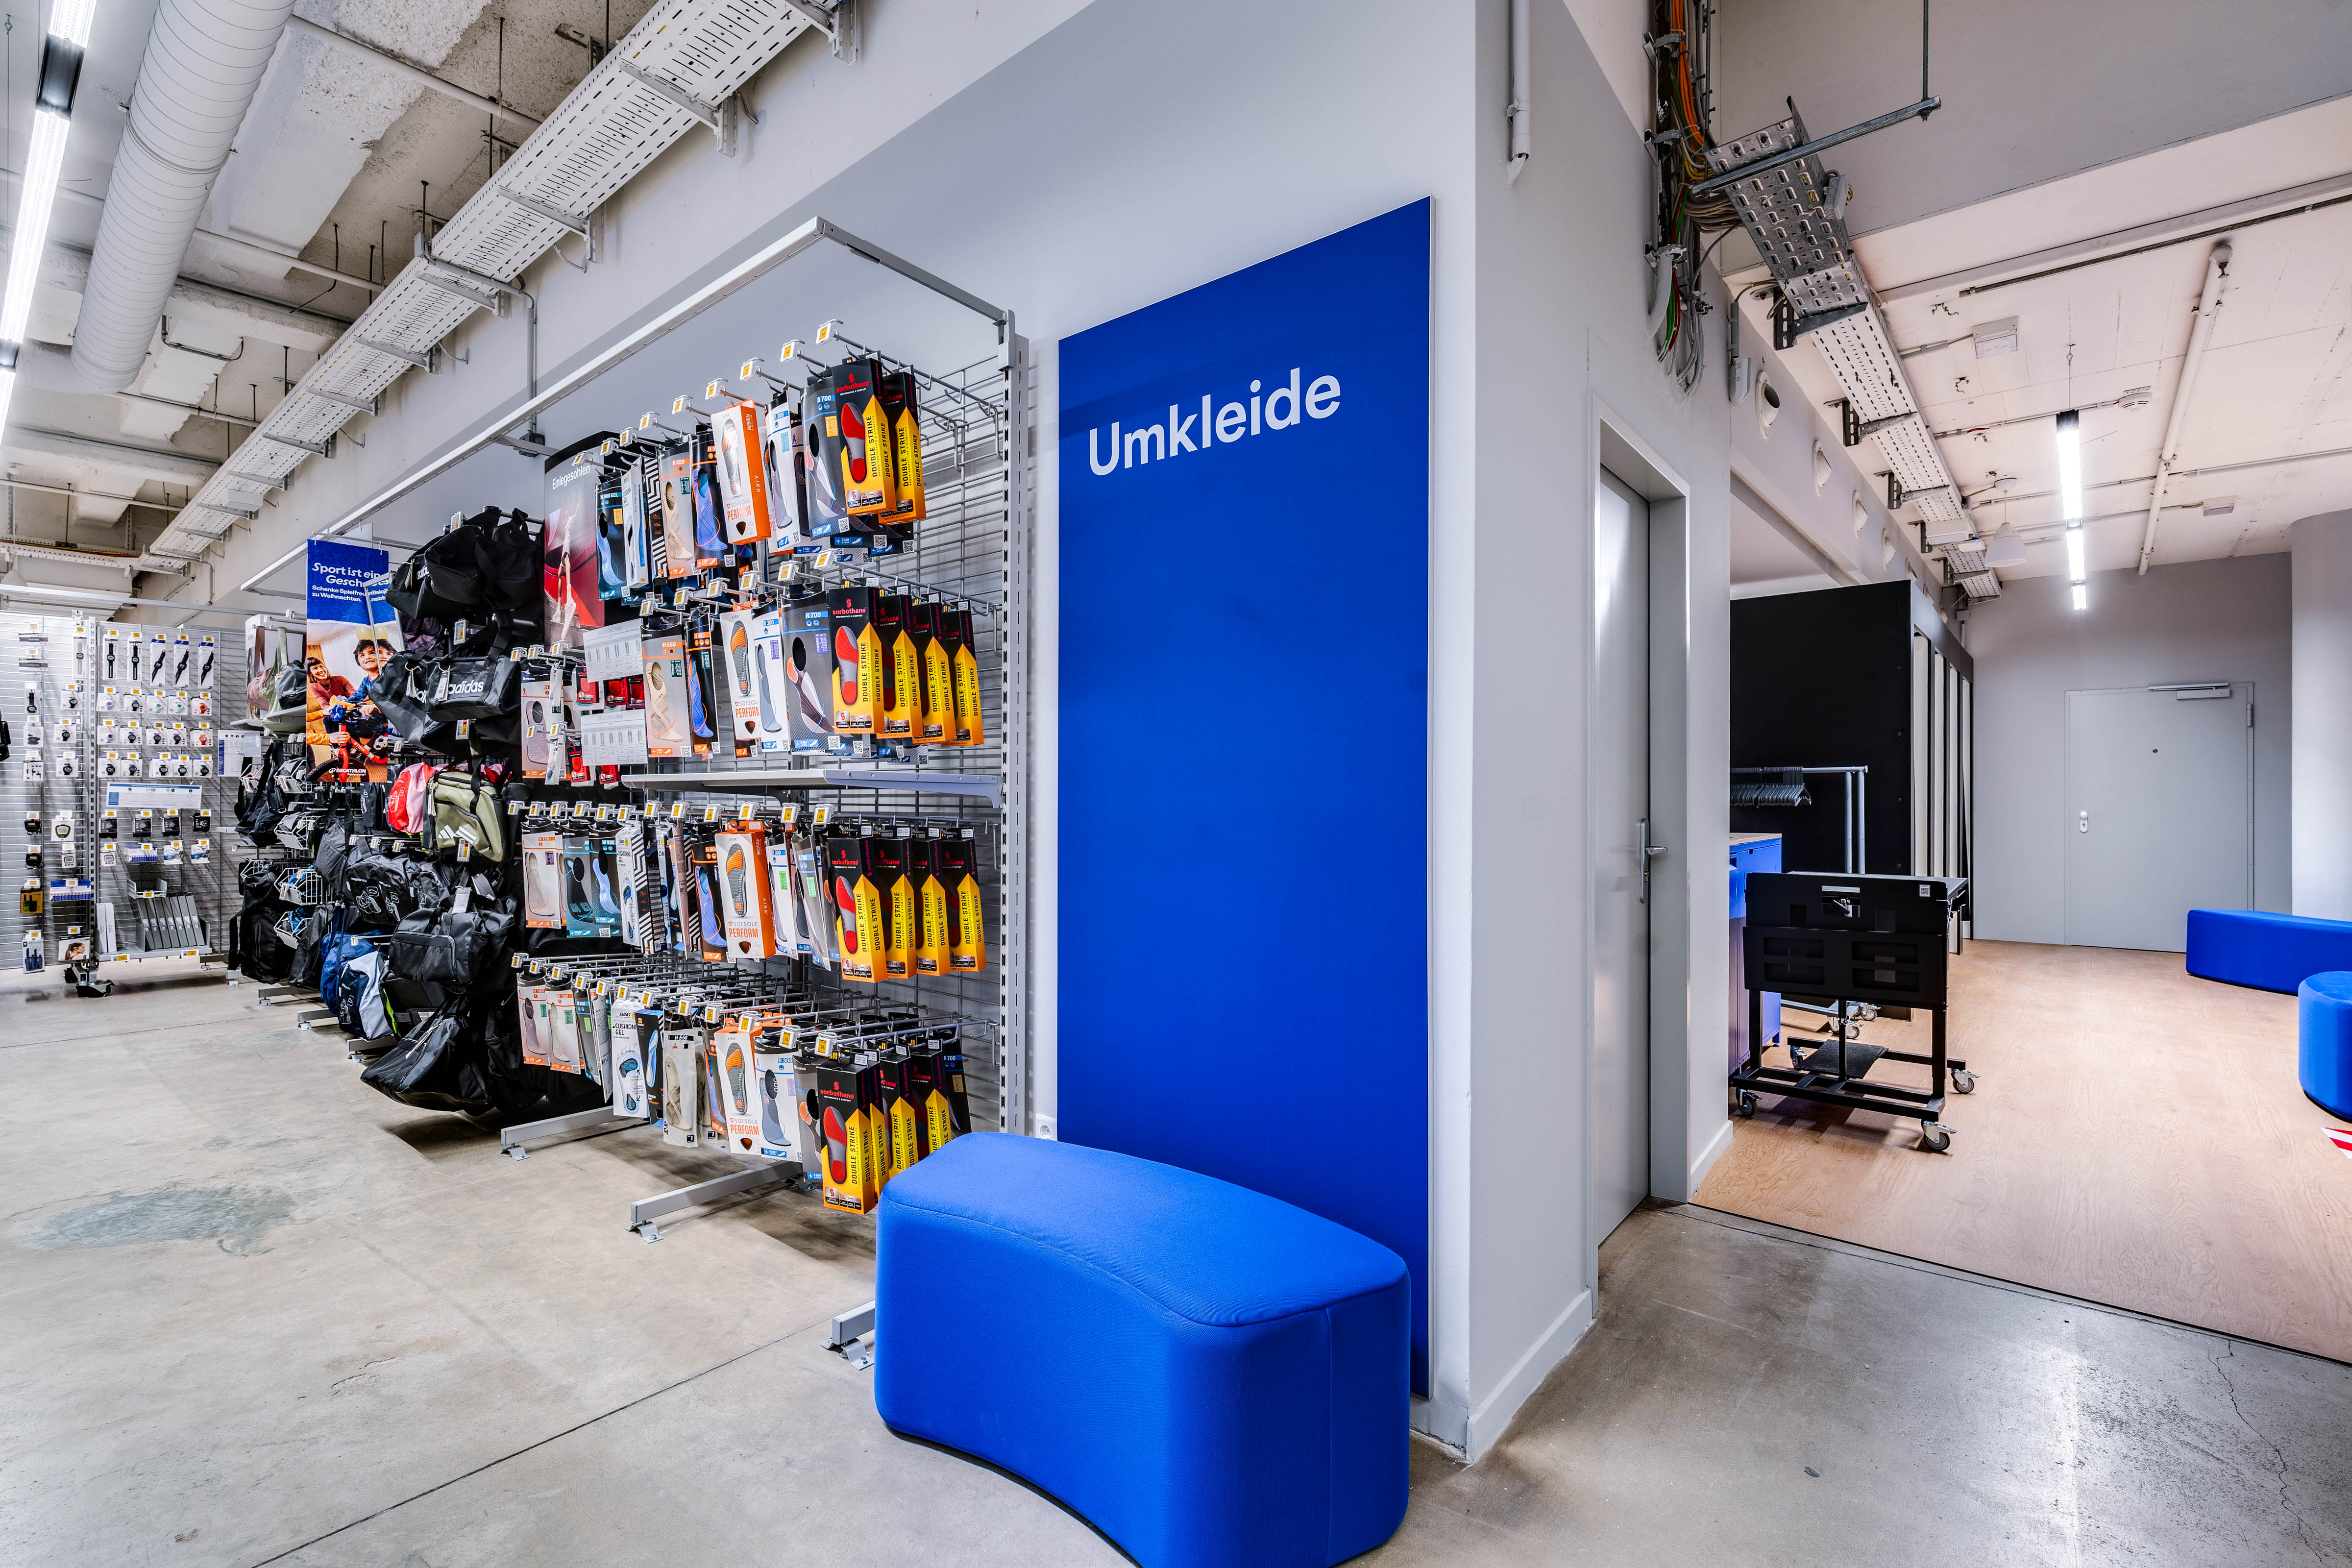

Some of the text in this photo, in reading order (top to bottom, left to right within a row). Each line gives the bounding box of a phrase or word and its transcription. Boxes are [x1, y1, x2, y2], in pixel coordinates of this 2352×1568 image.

[836, 381, 869, 392] sorbothane
[1089, 367, 1341, 476] Umkleide
[869, 447, 877, 477] DOUBLE
[552, 466, 590, 490] Einlegesohlen
[901, 458, 909, 487] DOUBLE
[731, 498, 750, 508] SOFSOLE
[727, 505, 751, 521] PERFORM
[312, 563, 346, 574] Sport
[347, 567, 362, 577] ist
[326, 575, 364, 588] Gesch
[320, 593, 362, 602] Weihnachten.
[448, 680, 484, 694] adidas
[729, 928, 759, 938] PERFORM
[820, 1089, 854, 1099] sorbothane
[730, 1125, 759, 1135] PERFORM
